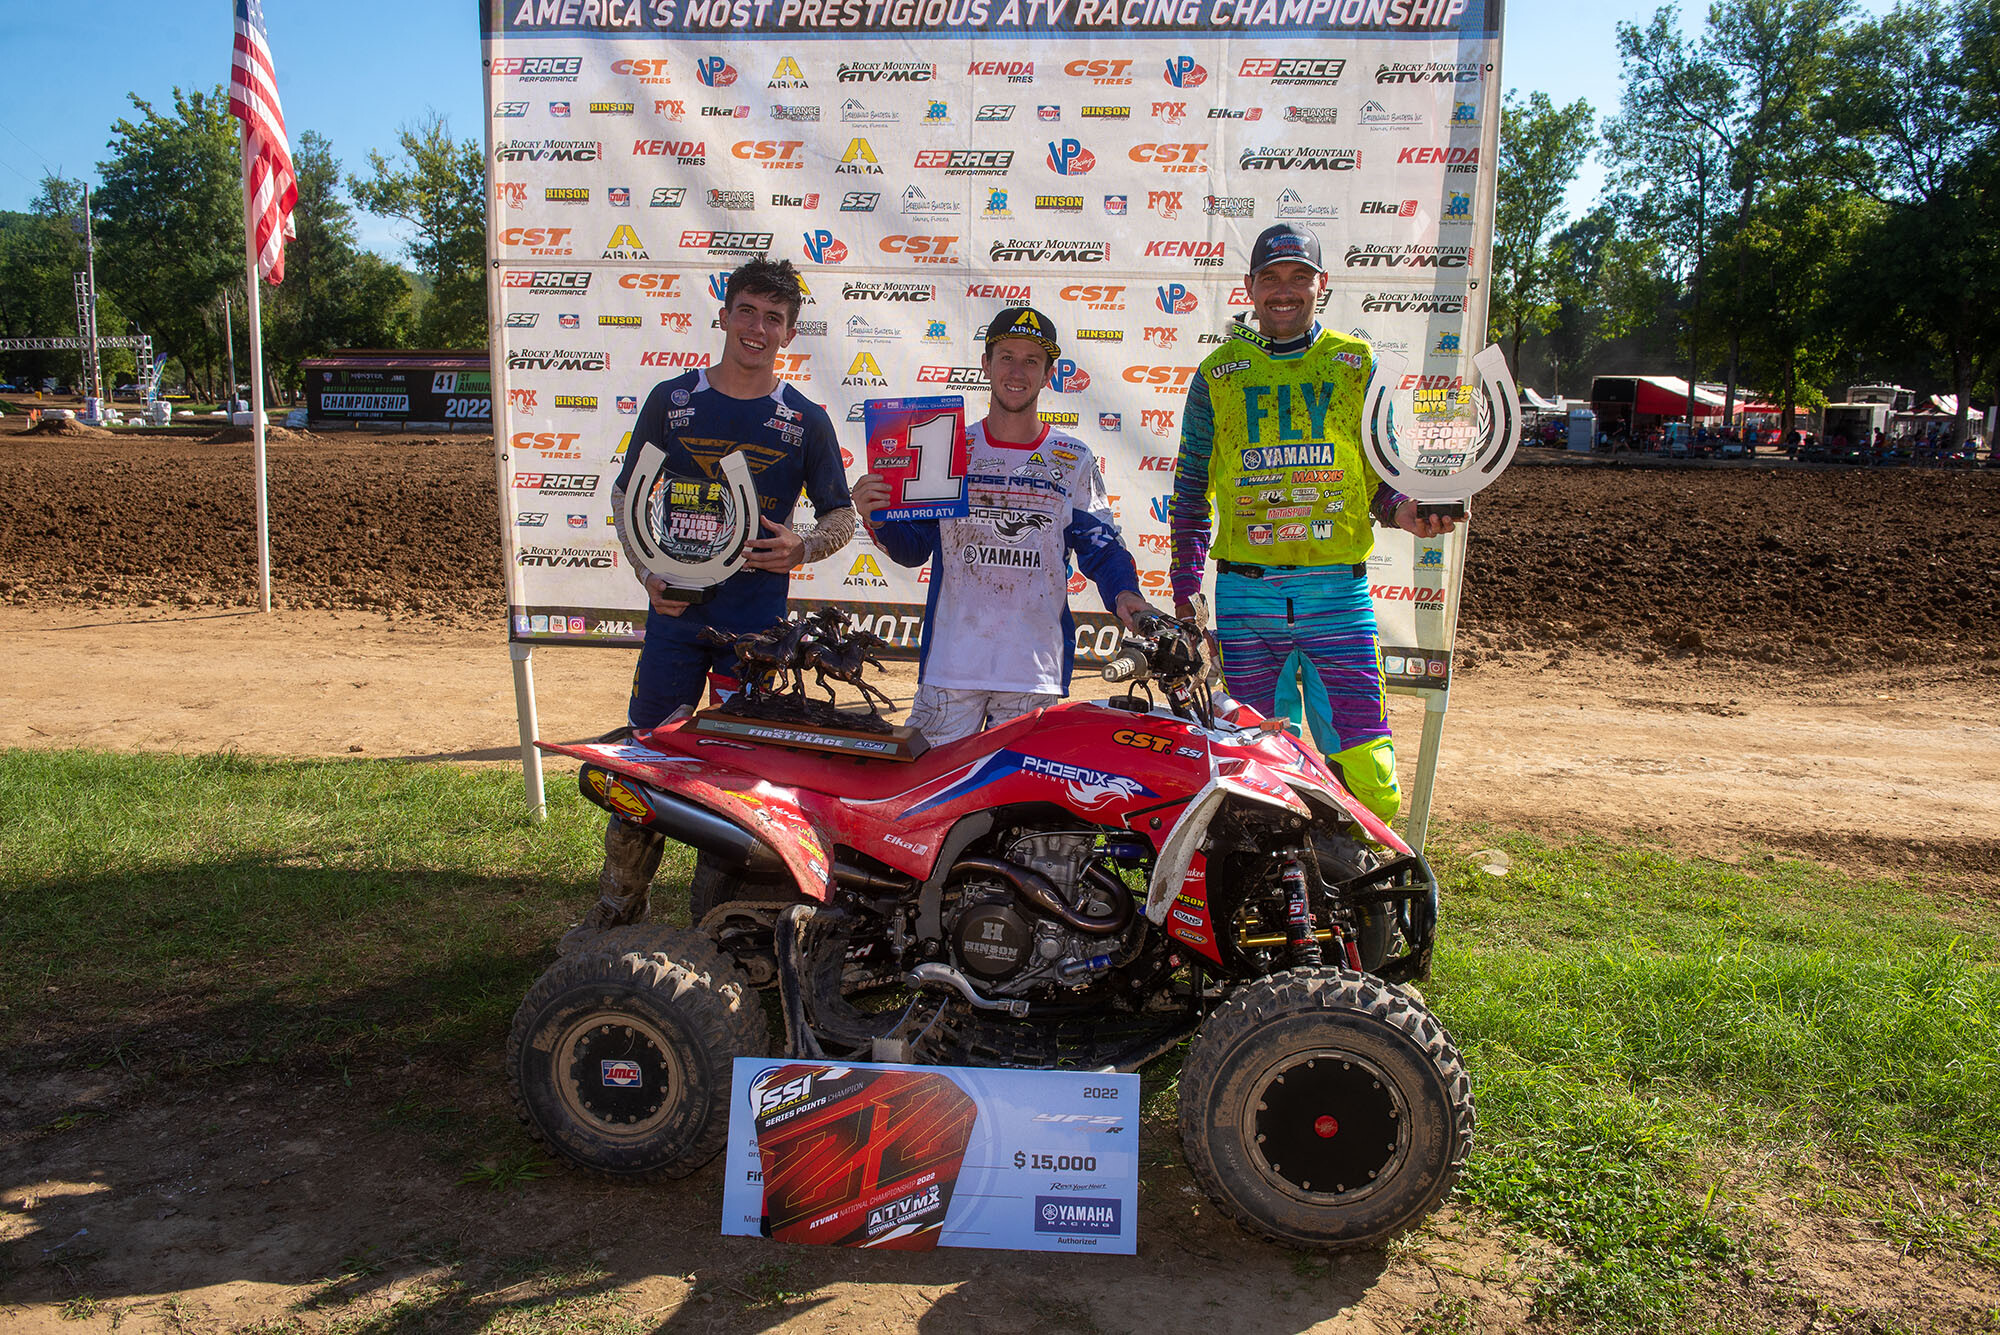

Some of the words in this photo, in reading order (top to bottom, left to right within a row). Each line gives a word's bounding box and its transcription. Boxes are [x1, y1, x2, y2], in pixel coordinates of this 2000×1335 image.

[514, 0, 674, 26] AMERICA'S
[683, 0, 772, 26] MOST
[778, 0, 991, 27] PRESTIGIOUS
[997, 0, 1066, 26] ATV
[1074, 0, 1201, 26] RACING
[1210, 0, 1469, 27] CHAMPIONSHIP
[610, 59, 668, 76] CST
[967, 61, 1035, 76] KENDA
[1064, 59, 1133, 77] CST
[639, 77, 671, 85] TIRES
[767, 80, 809, 89] ARMA
[1008, 76, 1034, 84] TIRES
[1093, 78, 1133, 86] TIRES
[590, 103, 634, 113] HINSON
[701, 107, 732, 117] Elka
[1082, 106, 1131, 116] HINSON
[1207, 109, 1244, 119] Elka
[633, 140, 706, 157] KENDA
[731, 140, 804, 159] CST
[1128, 143, 1208, 163] CST
[1397, 147, 1479, 164] KENDA
[677, 157, 705, 166] TIRES
[761, 161, 804, 169] TIRES
[1447, 164, 1478, 173] TIRES
[835, 165, 883, 175] ARMA
[1162, 165, 1207, 173] TIRES
[546, 188, 590, 200] HINSON
[771, 194, 802, 207] Elka
[1035, 196, 1083, 207] HINSON
[1360, 200, 1400, 214] Elka
[499, 228, 572, 246] CST
[879, 235, 959, 254] CST
[1144, 241, 1225, 257] KENDA
[601, 251, 649, 260] ARMA
[912, 256, 959, 264] TIRES
[1193, 258, 1224, 267] TIRES
[618, 273, 680, 290] CST
[966, 284, 1031, 299] KENDA
[1060, 285, 1126, 302] CST
[1005, 299, 1031, 307] TIRES
[1088, 303, 1126, 311] TIRES
[599, 316, 642, 325] HINSON
[1010, 325, 1042, 337] ARMA
[1077, 329, 1123, 339] HINSON
[1232, 324, 1271, 348] SCOTT
[640, 352, 711, 368] KENDA
[1334, 353, 1362, 368] AMA
[435, 374, 453, 390] 41
[841, 377, 889, 387] ARMA
[1122, 366, 1197, 384] CST
[458, 382, 491, 392] ANNUA
[323, 395, 406, 409] CHAMPIONSHIP
[555, 396, 598, 408] HINSON
[1419, 389, 1448, 401] DIRT
[445, 399, 491, 418] 2022
[1243, 382, 1334, 443] FLY
[1413, 401, 1447, 413] DAYS
[1140, 410, 1175, 430] FOX
[1405, 427, 1478, 439] SECOND
[510, 432, 580, 450] CST
[1413, 438, 1469, 450] PLACE
[902, 413, 963, 504] 1
[1263, 446, 1333, 467] YAMAHA
[1291, 470, 1344, 484] MAXXIS
[675, 483, 701, 494] DIRT
[1008, 476, 1067, 497] RACING
[671, 494, 699, 505] DAYS
[886, 509, 911, 520] AMA
[912, 509, 934, 519] PRO
[935, 508, 955, 517] ATV
[968, 508, 1027, 522] HOENIX
[671, 518, 718, 530] THIRD
[669, 528, 717, 541] PLACE
[980, 548, 1041, 568] YAMAHA
[843, 578, 888, 588] ARMA
[1369, 585, 1445, 603] KENDA
[1414, 602, 1444, 611] TIRES
[592, 620, 635, 636] AMA
[748, 728, 795, 740] FIRST
[796, 732, 845, 747] PLACE
[1113, 729, 1174, 752] CST
[1176, 747, 1205, 760] SSI
[1021, 768, 1066, 785] RACING
[1022, 756, 1109, 787] PHOENIX
[883, 833, 914, 851] Elka
[1177, 894, 1205, 908] NSON
[1174, 910, 1201, 925] EVANS
[964, 941, 1018, 957] HINSON
[761, 1073, 813, 1113] SSI
[1083, 1087, 1119, 1100] 2022
[760, 1094, 810, 1117] DECALS
[765, 1110, 795, 1128] SERIES
[796, 1097, 827, 1115] POINTS
[827, 1082, 864, 1103] CHAMPION
[1014, 1150, 1026, 1170] $
[1031, 1154, 1097, 1173] 15,000
[809, 1212, 839, 1230] ATVMX
[839, 1200, 869, 1218] NATIONAL
[869, 1181, 917, 1205] CHAMPIONSHIP
[917, 1172, 936, 1185] 2022
[868, 1221, 897, 1236] NATIONAL
[897, 1202, 940, 1225] CHAMPIONSHIP
[1059, 1205, 1114, 1222] YAMAHA
[1057, 1236, 1097, 1246] Authorized
